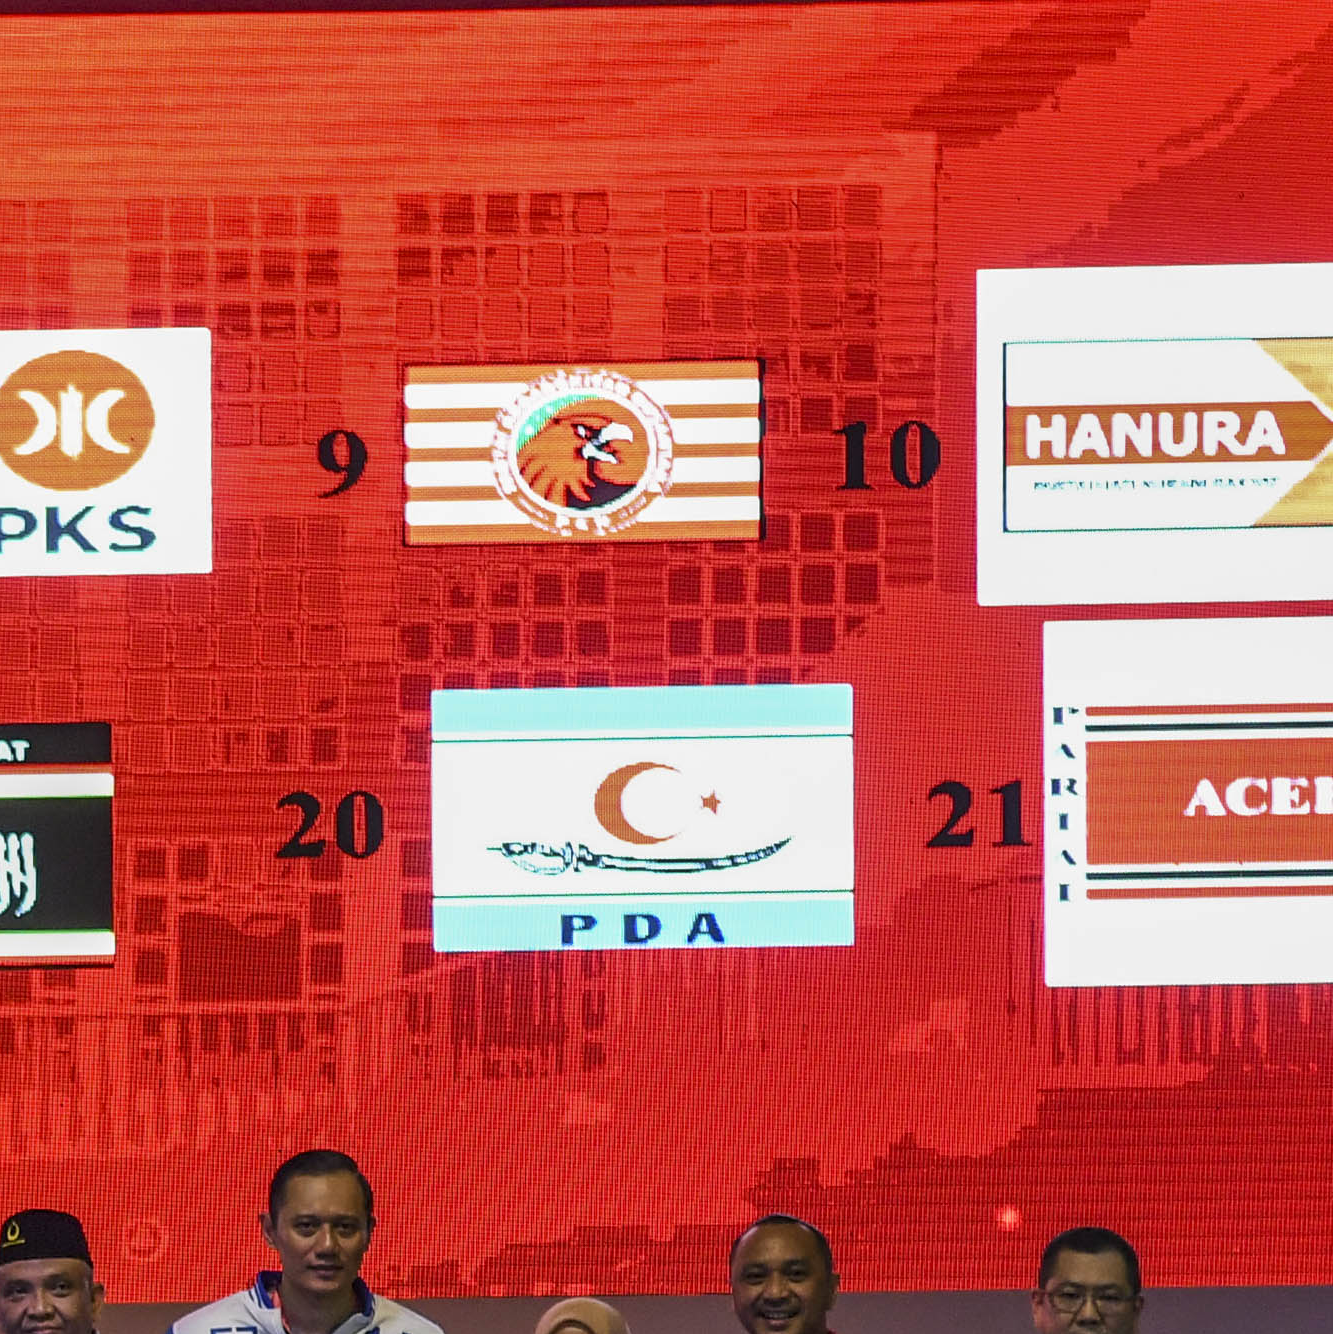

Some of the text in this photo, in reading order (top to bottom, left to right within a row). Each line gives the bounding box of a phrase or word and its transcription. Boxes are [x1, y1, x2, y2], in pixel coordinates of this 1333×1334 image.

[317, 429, 368, 498] 9
[834, 420, 942, 491] 10
[1025, 410, 1286, 459] HANURA
[275, 790, 384, 860] 20
[926, 779, 1033, 848] 21
[560, 912, 725, 946] PDA
